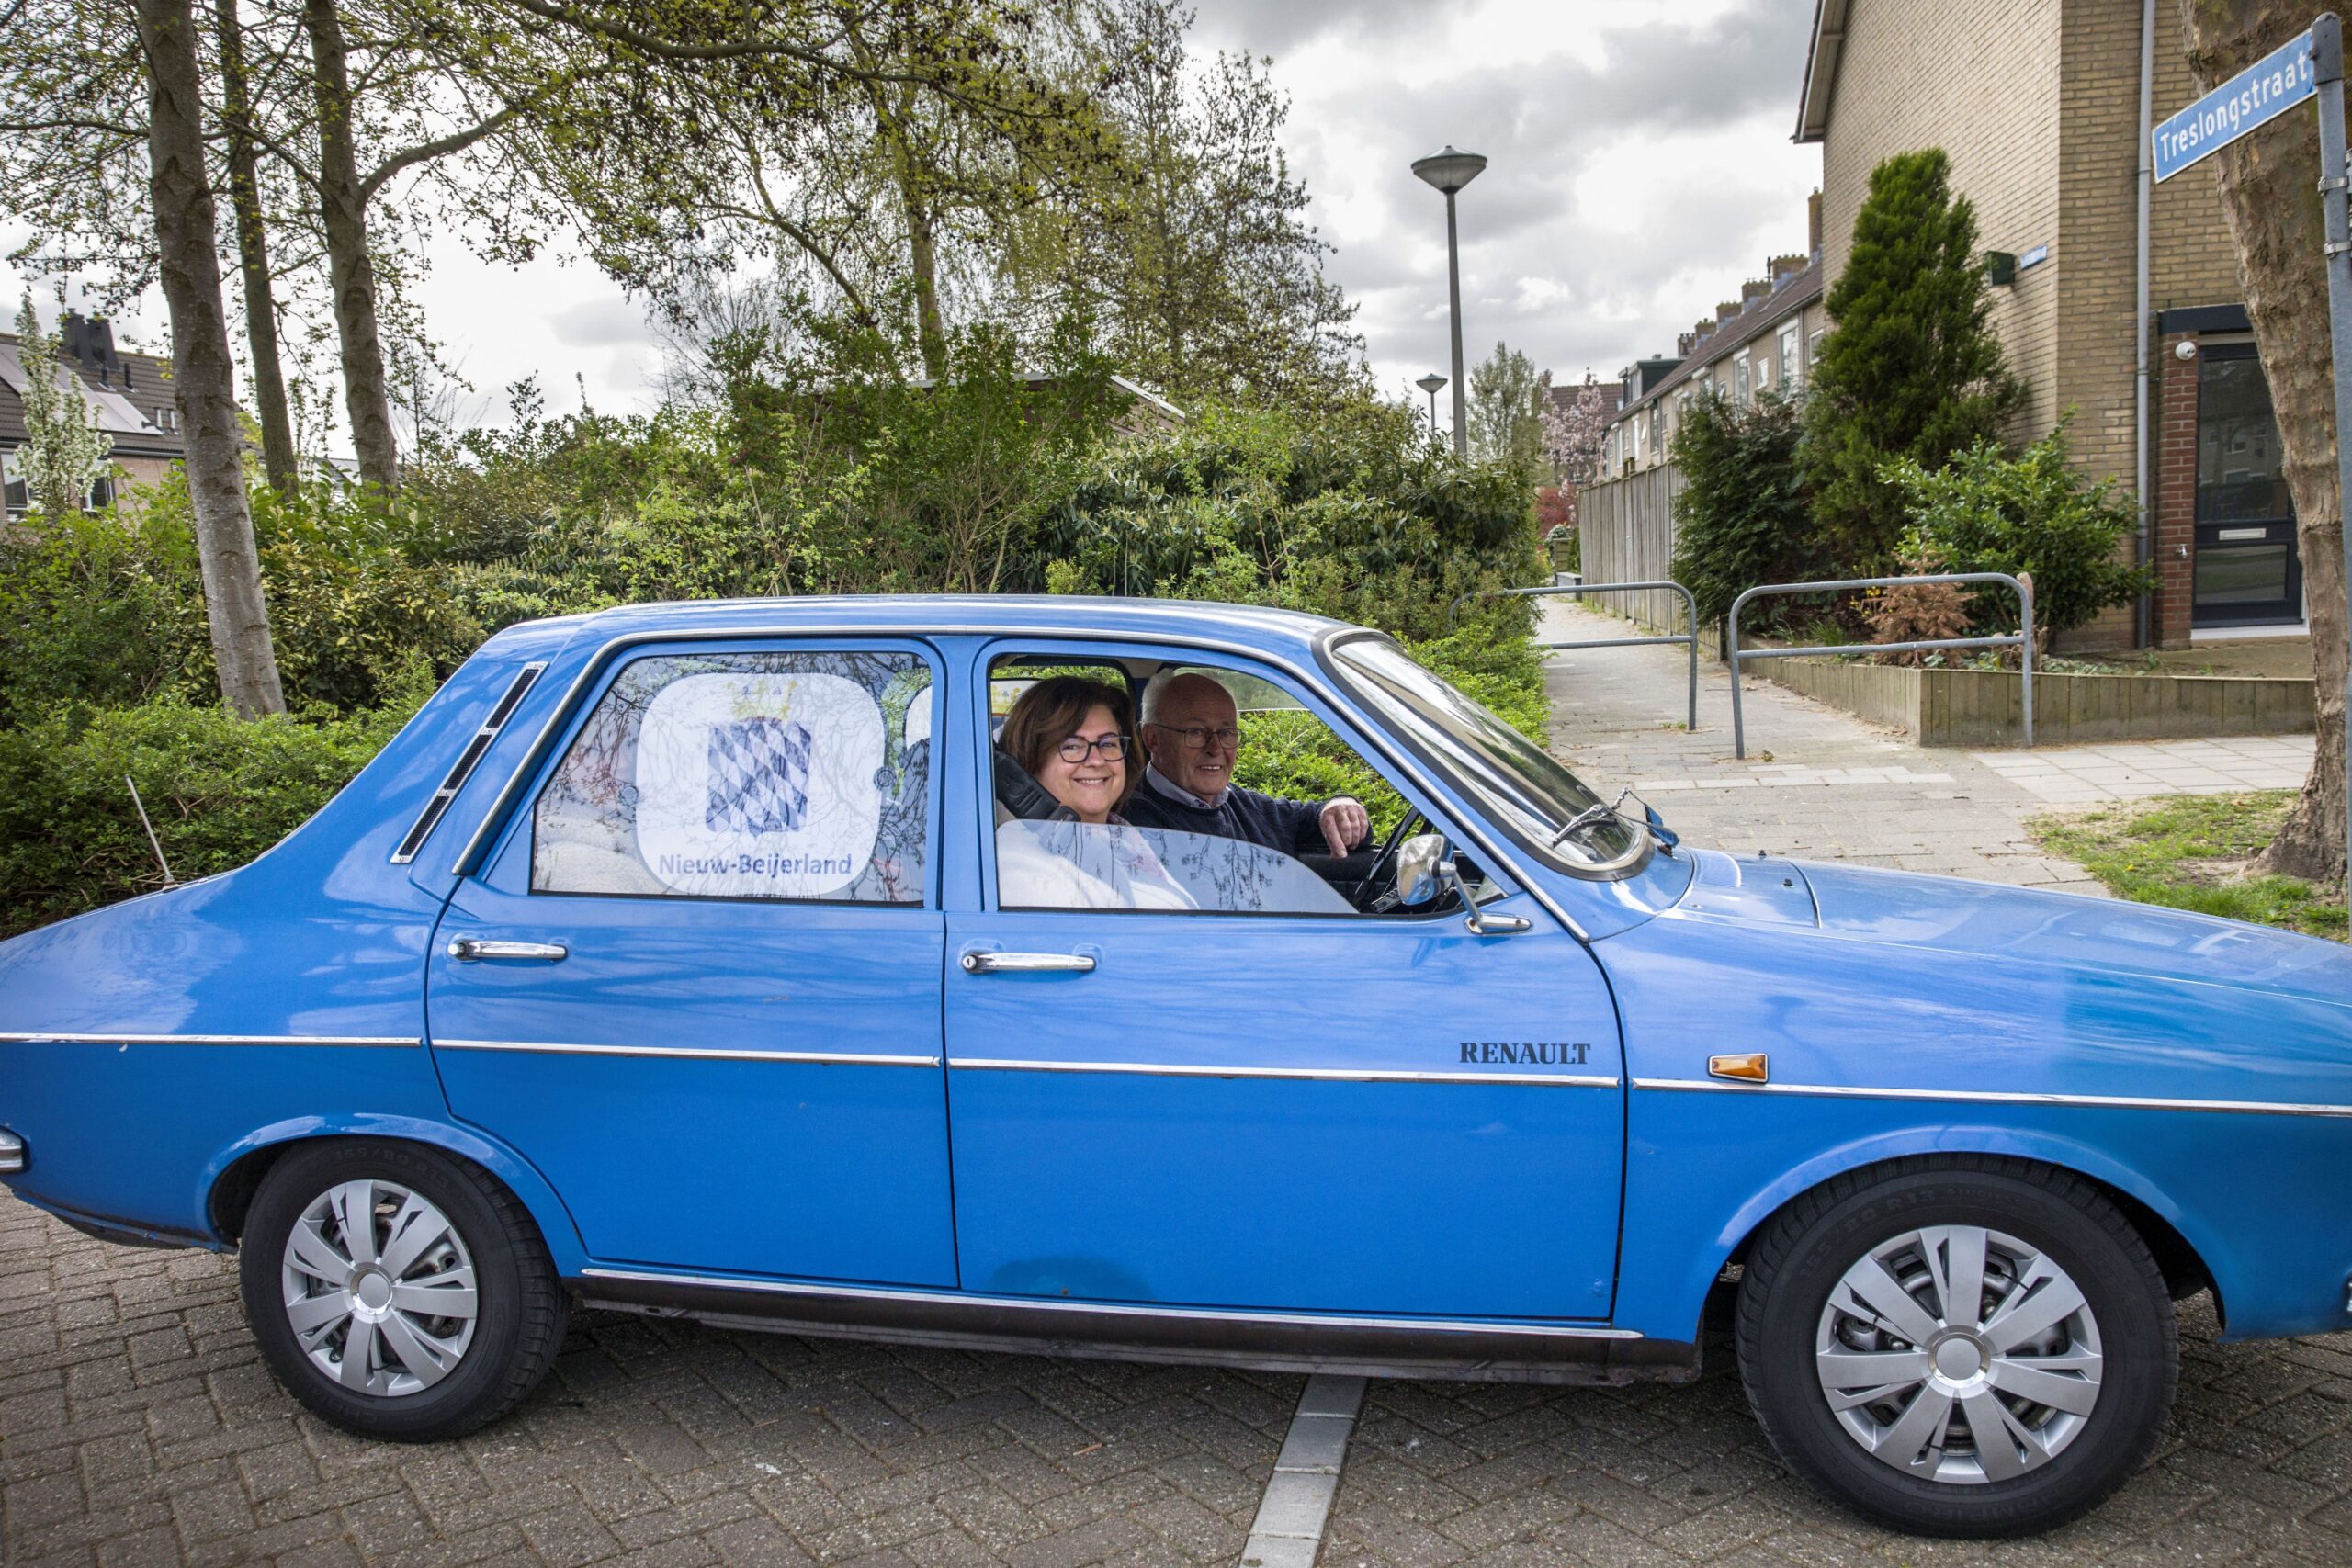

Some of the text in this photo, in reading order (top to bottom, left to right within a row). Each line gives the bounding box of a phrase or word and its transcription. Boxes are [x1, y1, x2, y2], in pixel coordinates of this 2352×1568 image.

[2160, 50, 2308, 162] Treslongstraat
[659, 852, 852, 878] Nieuw-Beijerland
[1459, 1042, 1591, 1065] RENAULT
